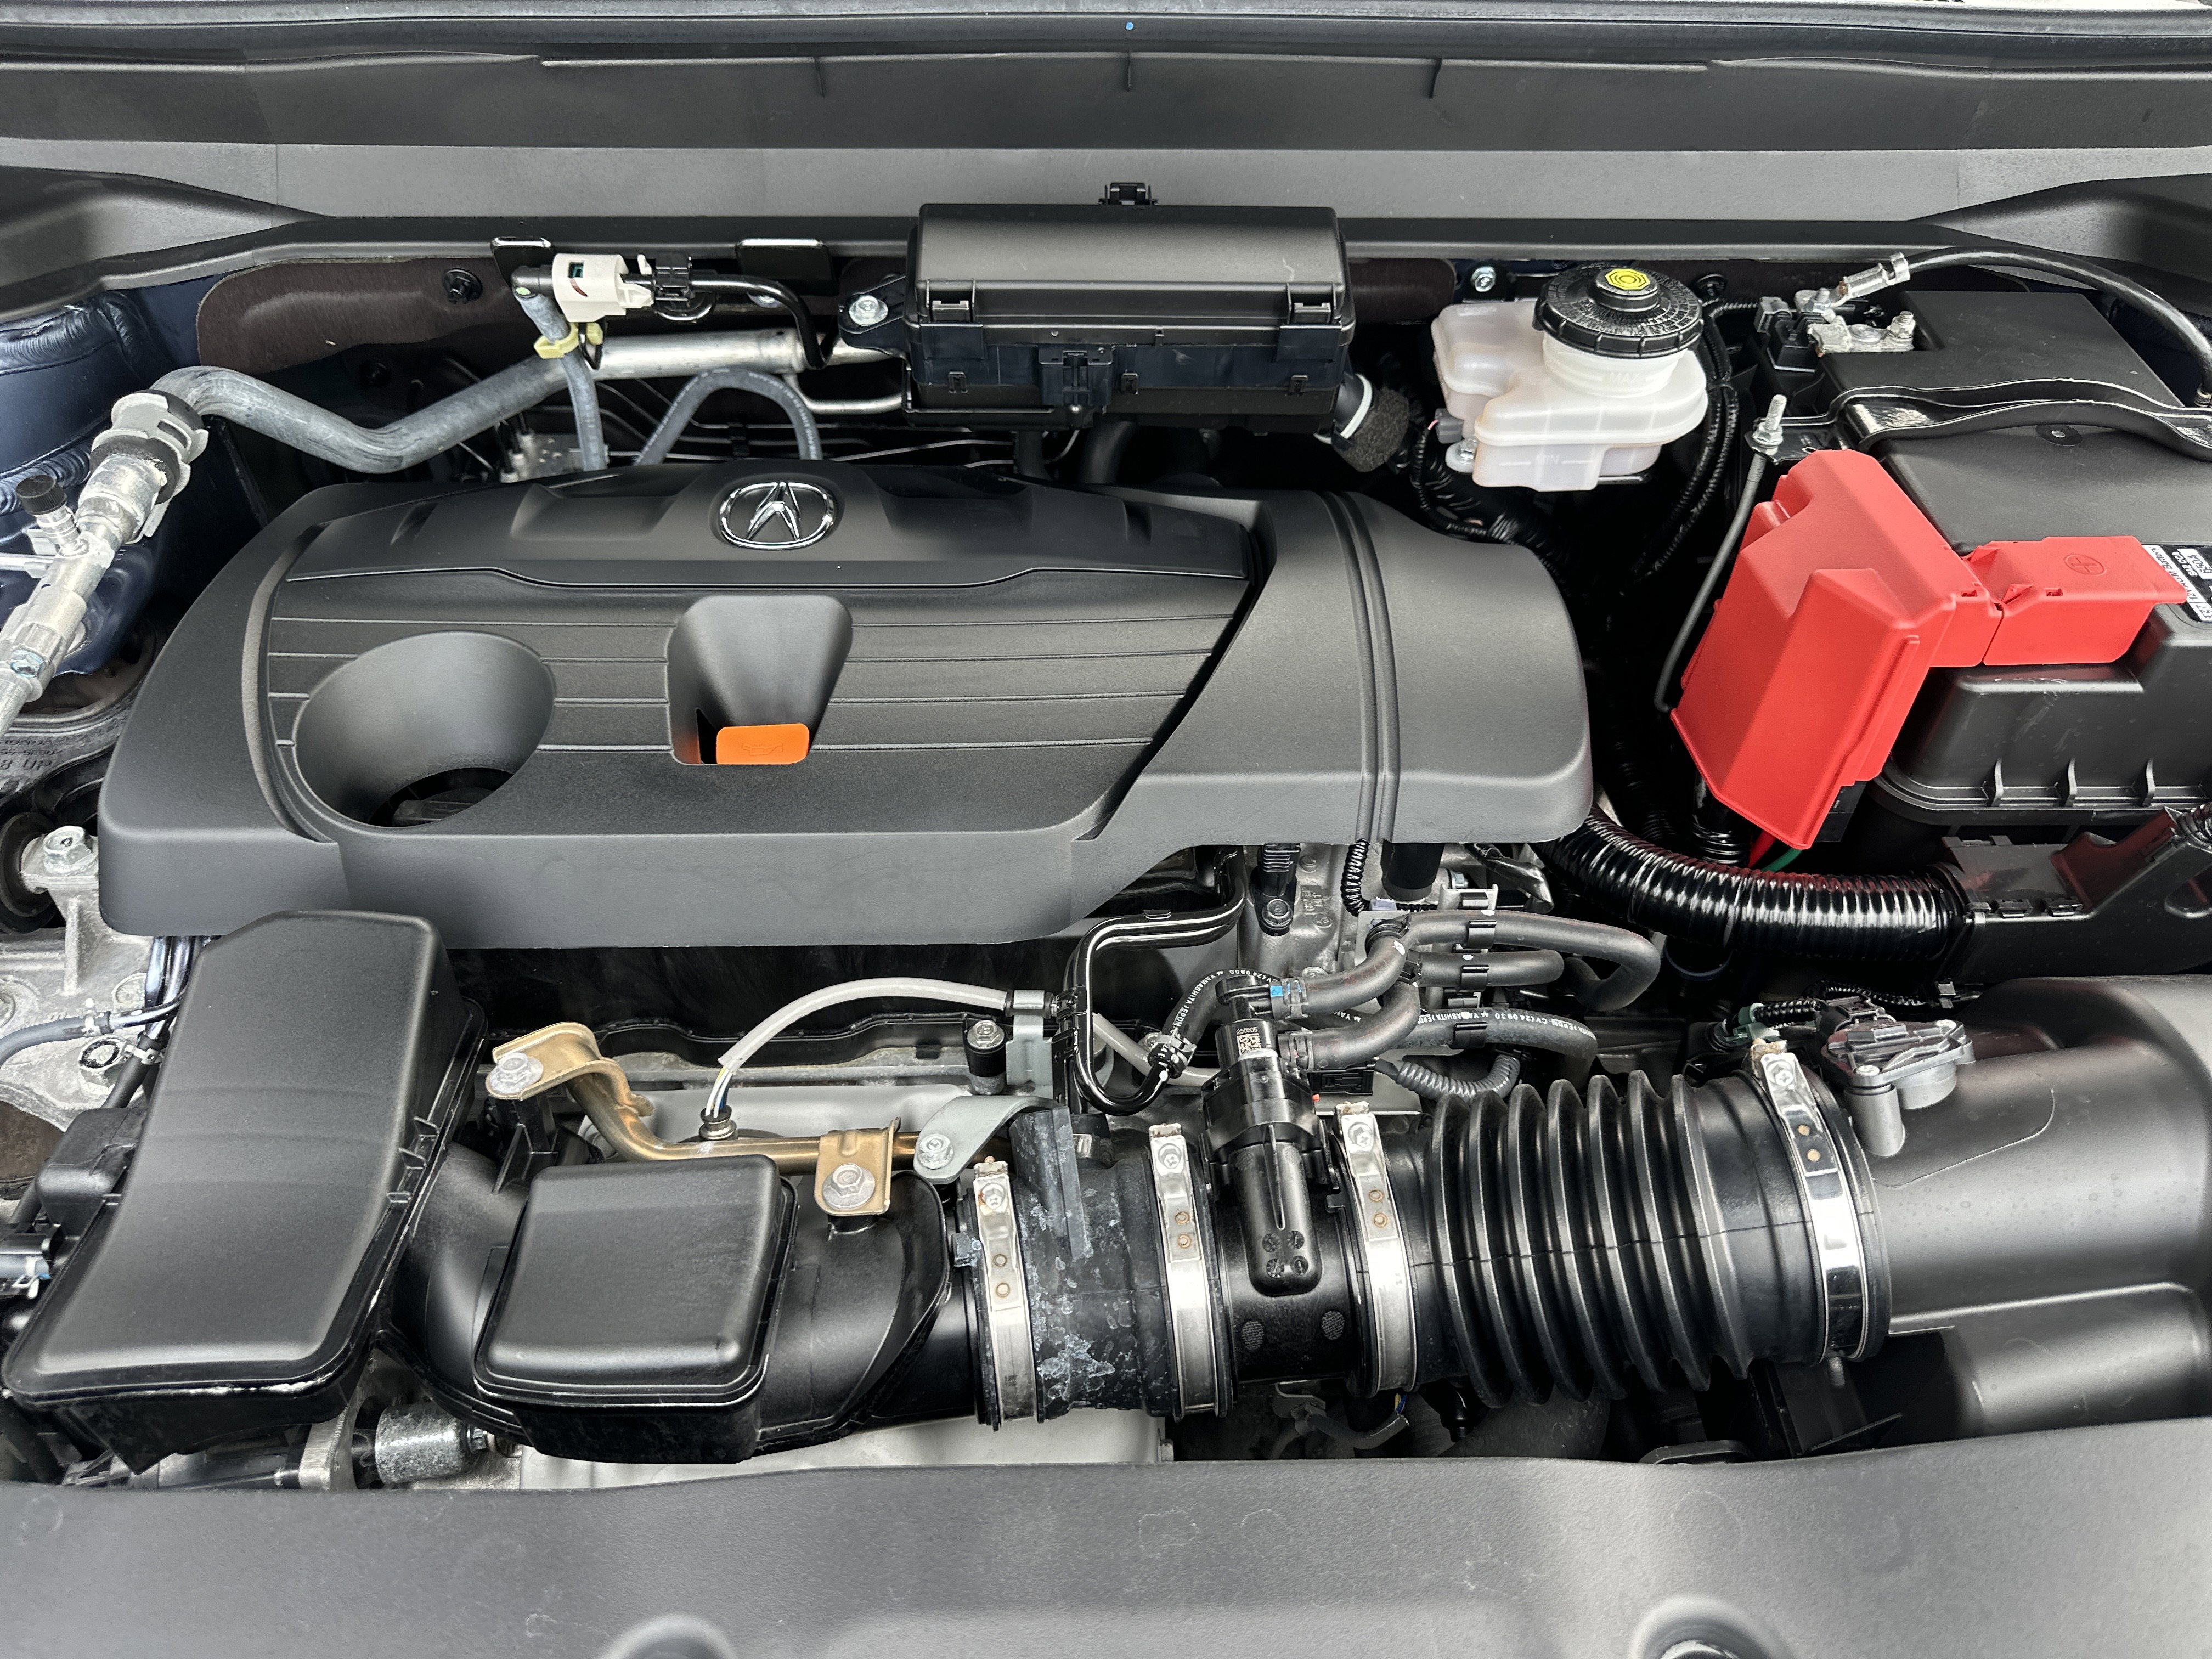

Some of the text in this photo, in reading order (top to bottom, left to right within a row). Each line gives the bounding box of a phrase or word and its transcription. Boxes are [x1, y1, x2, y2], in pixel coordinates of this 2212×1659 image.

[1610, 373, 1640, 385] MAX
[2171, 551, 2187, 564] CCA
[1236, 1026, 1258, 1035] 250505
